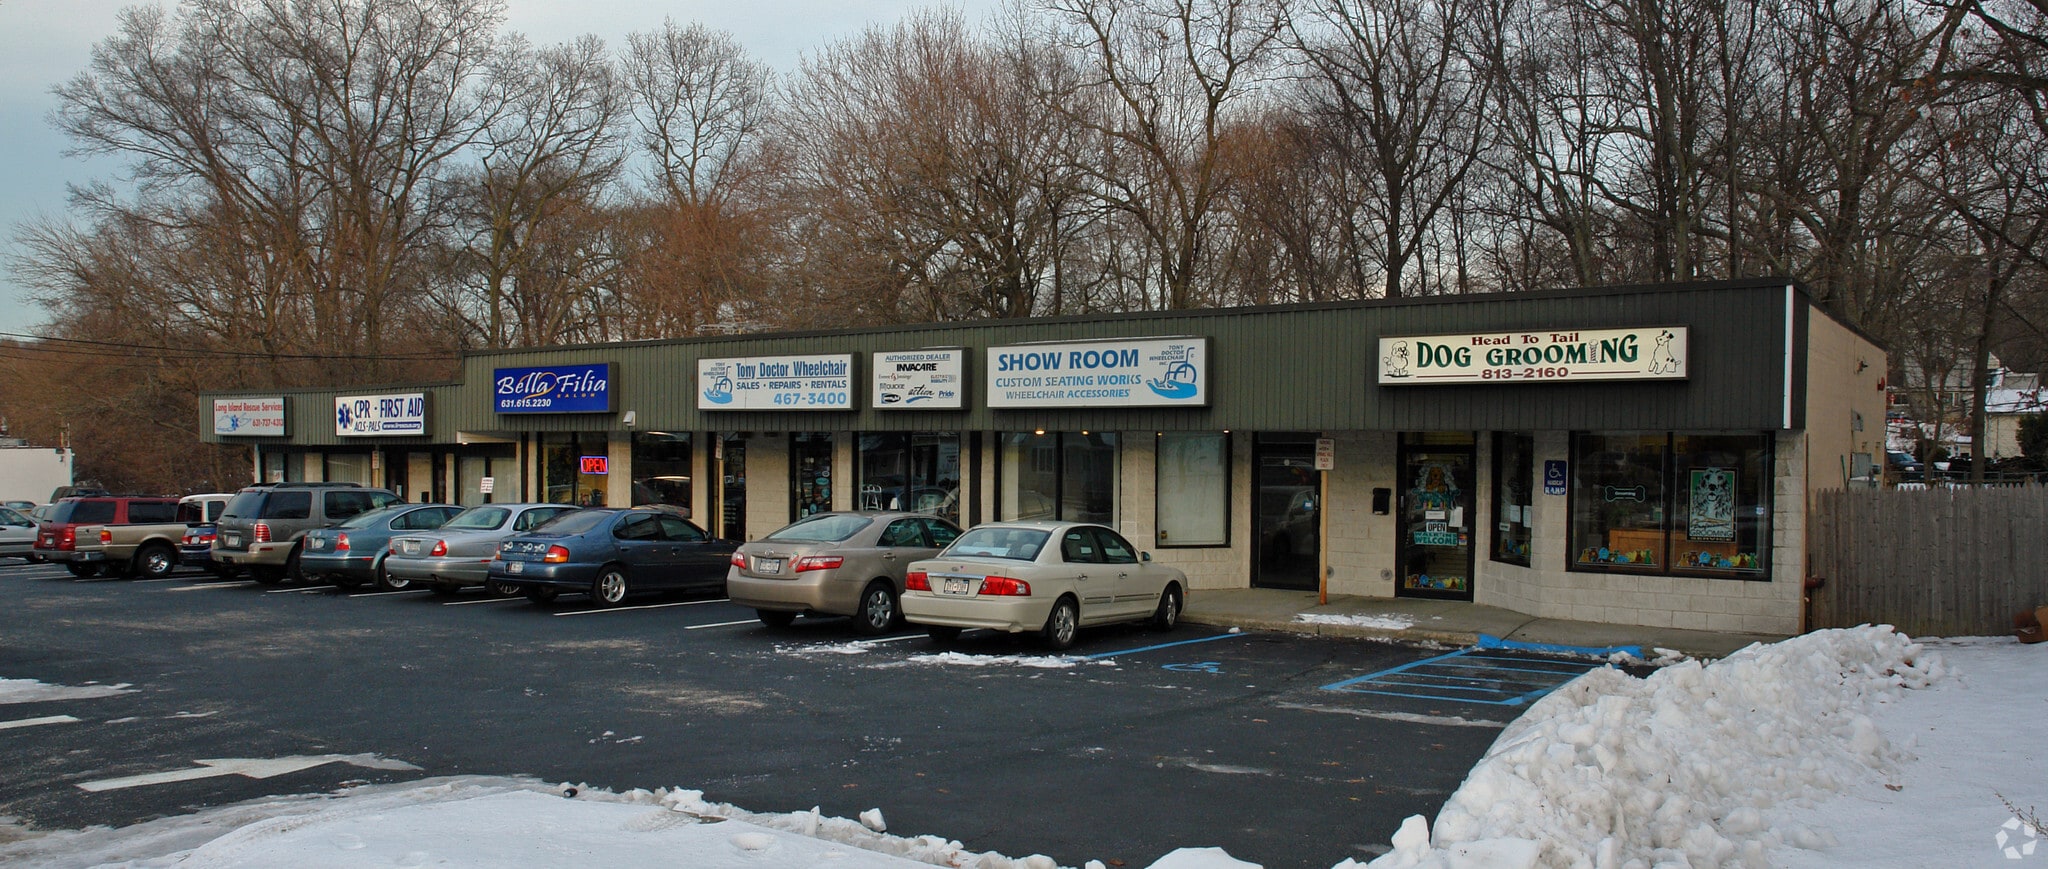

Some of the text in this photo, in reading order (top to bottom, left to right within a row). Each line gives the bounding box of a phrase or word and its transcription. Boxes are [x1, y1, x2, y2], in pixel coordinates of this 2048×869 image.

[1471, 332, 1579, 346] Head To Tail
[998, 349, 1139, 371] SHOW ROOM
[1416, 341, 1471, 368] DOG
[736, 360, 847, 379] Tony Doctor Wheelchair
[896, 363, 937, 371] INVACARE
[1481, 367, 1569, 380] 813-2160
[497, 370, 606, 394] Bella Filia
[736, 379, 847, 389] SALES REPAIRS RENTALS
[995, 374, 1142, 388] CUSTOM SEATING WORKS
[773, 392, 847, 405] 467-3400
[938, 390, 955, 398] Pride
[1005, 389, 1131, 400] WHEELCHAIR ACCESSORIES
[216, 402, 283, 413] Long Island Rescue Services
[354, 398, 424, 418] CPR FIRST AID
[500, 399, 552, 408] 631.615.2230
[582, 458, 606, 472] OPEN
[1428, 522, 1446, 531] OPEN
[1414, 537, 1457, 545] WELCOME
